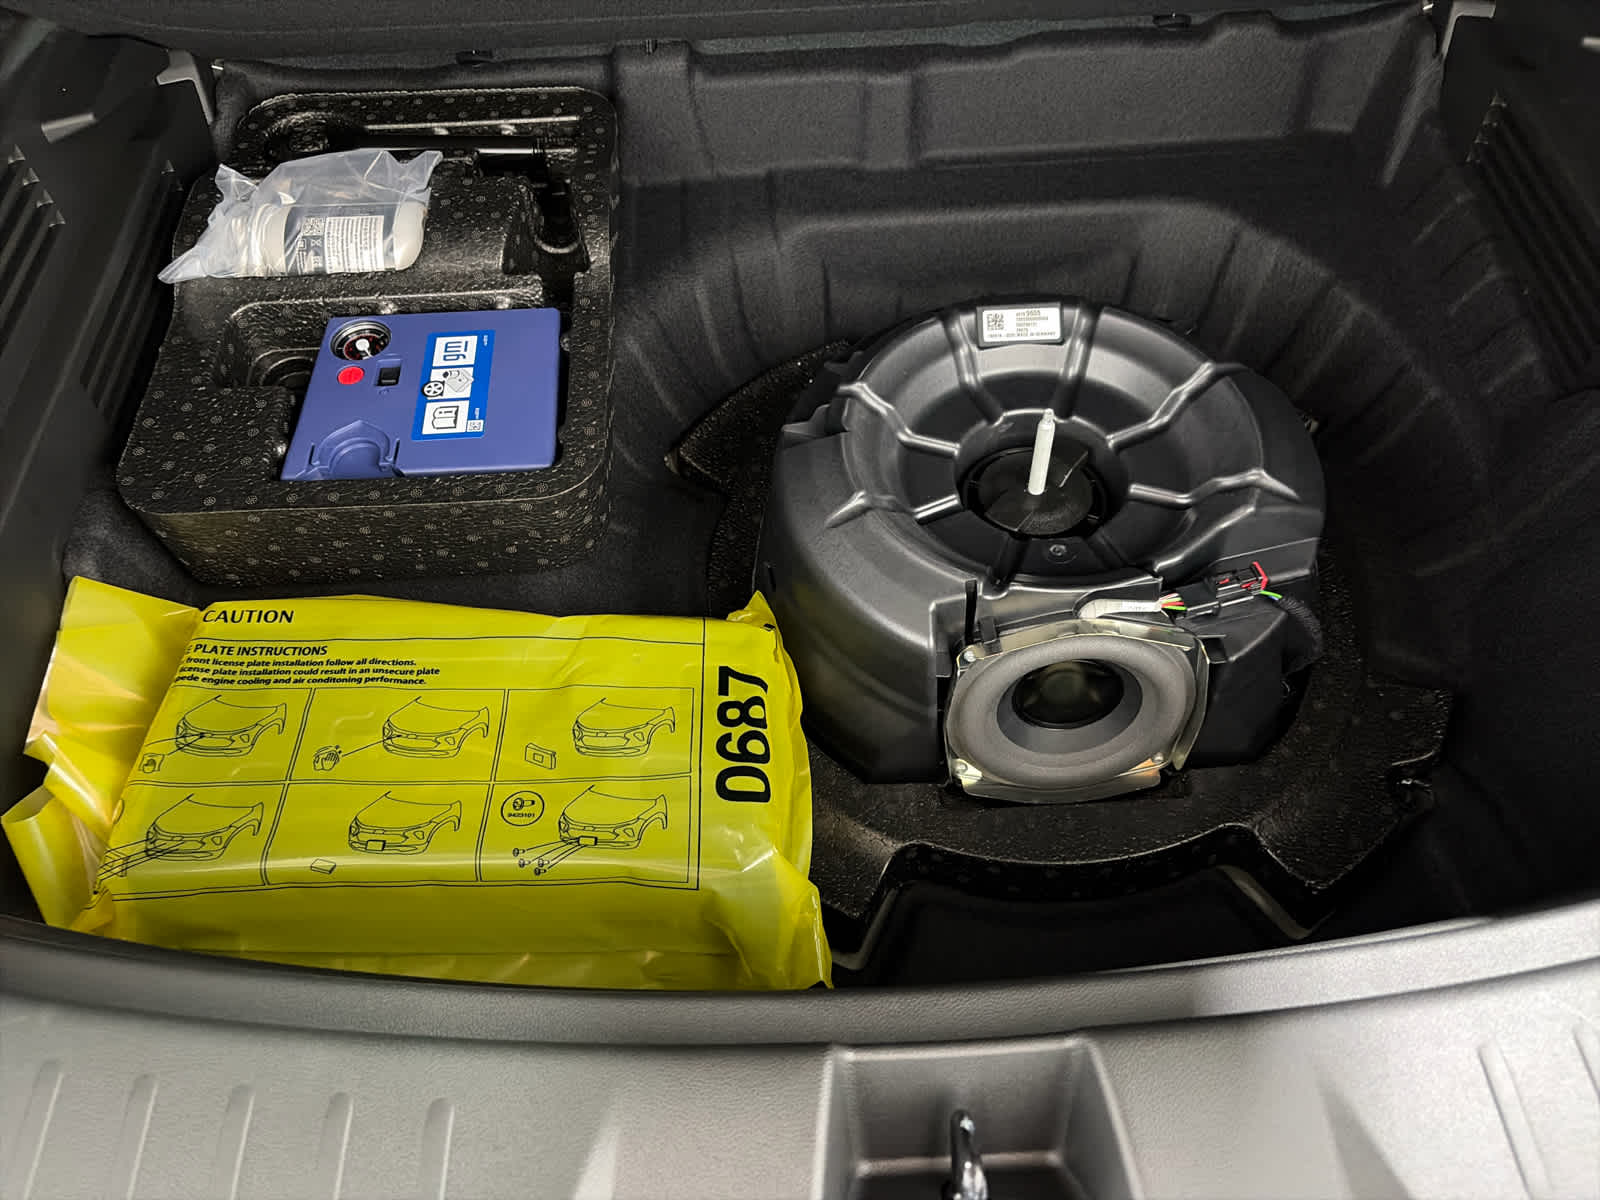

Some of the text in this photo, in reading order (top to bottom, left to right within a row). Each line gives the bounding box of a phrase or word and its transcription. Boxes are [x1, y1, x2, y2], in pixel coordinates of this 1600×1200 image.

[443, 341, 468, 361] gm
[202, 609, 294, 623] CAUTION
[193, 643, 235, 656] PLATE
[236, 645, 328, 657] INSTRUCTIONS
[186, 657, 417, 668] front license plate installation follow all directions.
[212, 667, 238, 676] plate
[239, 668, 291, 676] installation
[292, 667, 319, 676] could
[320, 667, 347, 676] result
[348, 667, 359, 675] in
[359, 667, 371, 675] an
[372, 667, 415, 676] unsecure
[415, 667, 441, 677] plate
[201, 676, 236, 686] engine
[236, 676, 271, 686] cooling
[272, 676, 292, 684] and
[292, 676, 306, 684] air
[363, 674, 427, 685] performance.
[715, 665, 771, 803] D687
